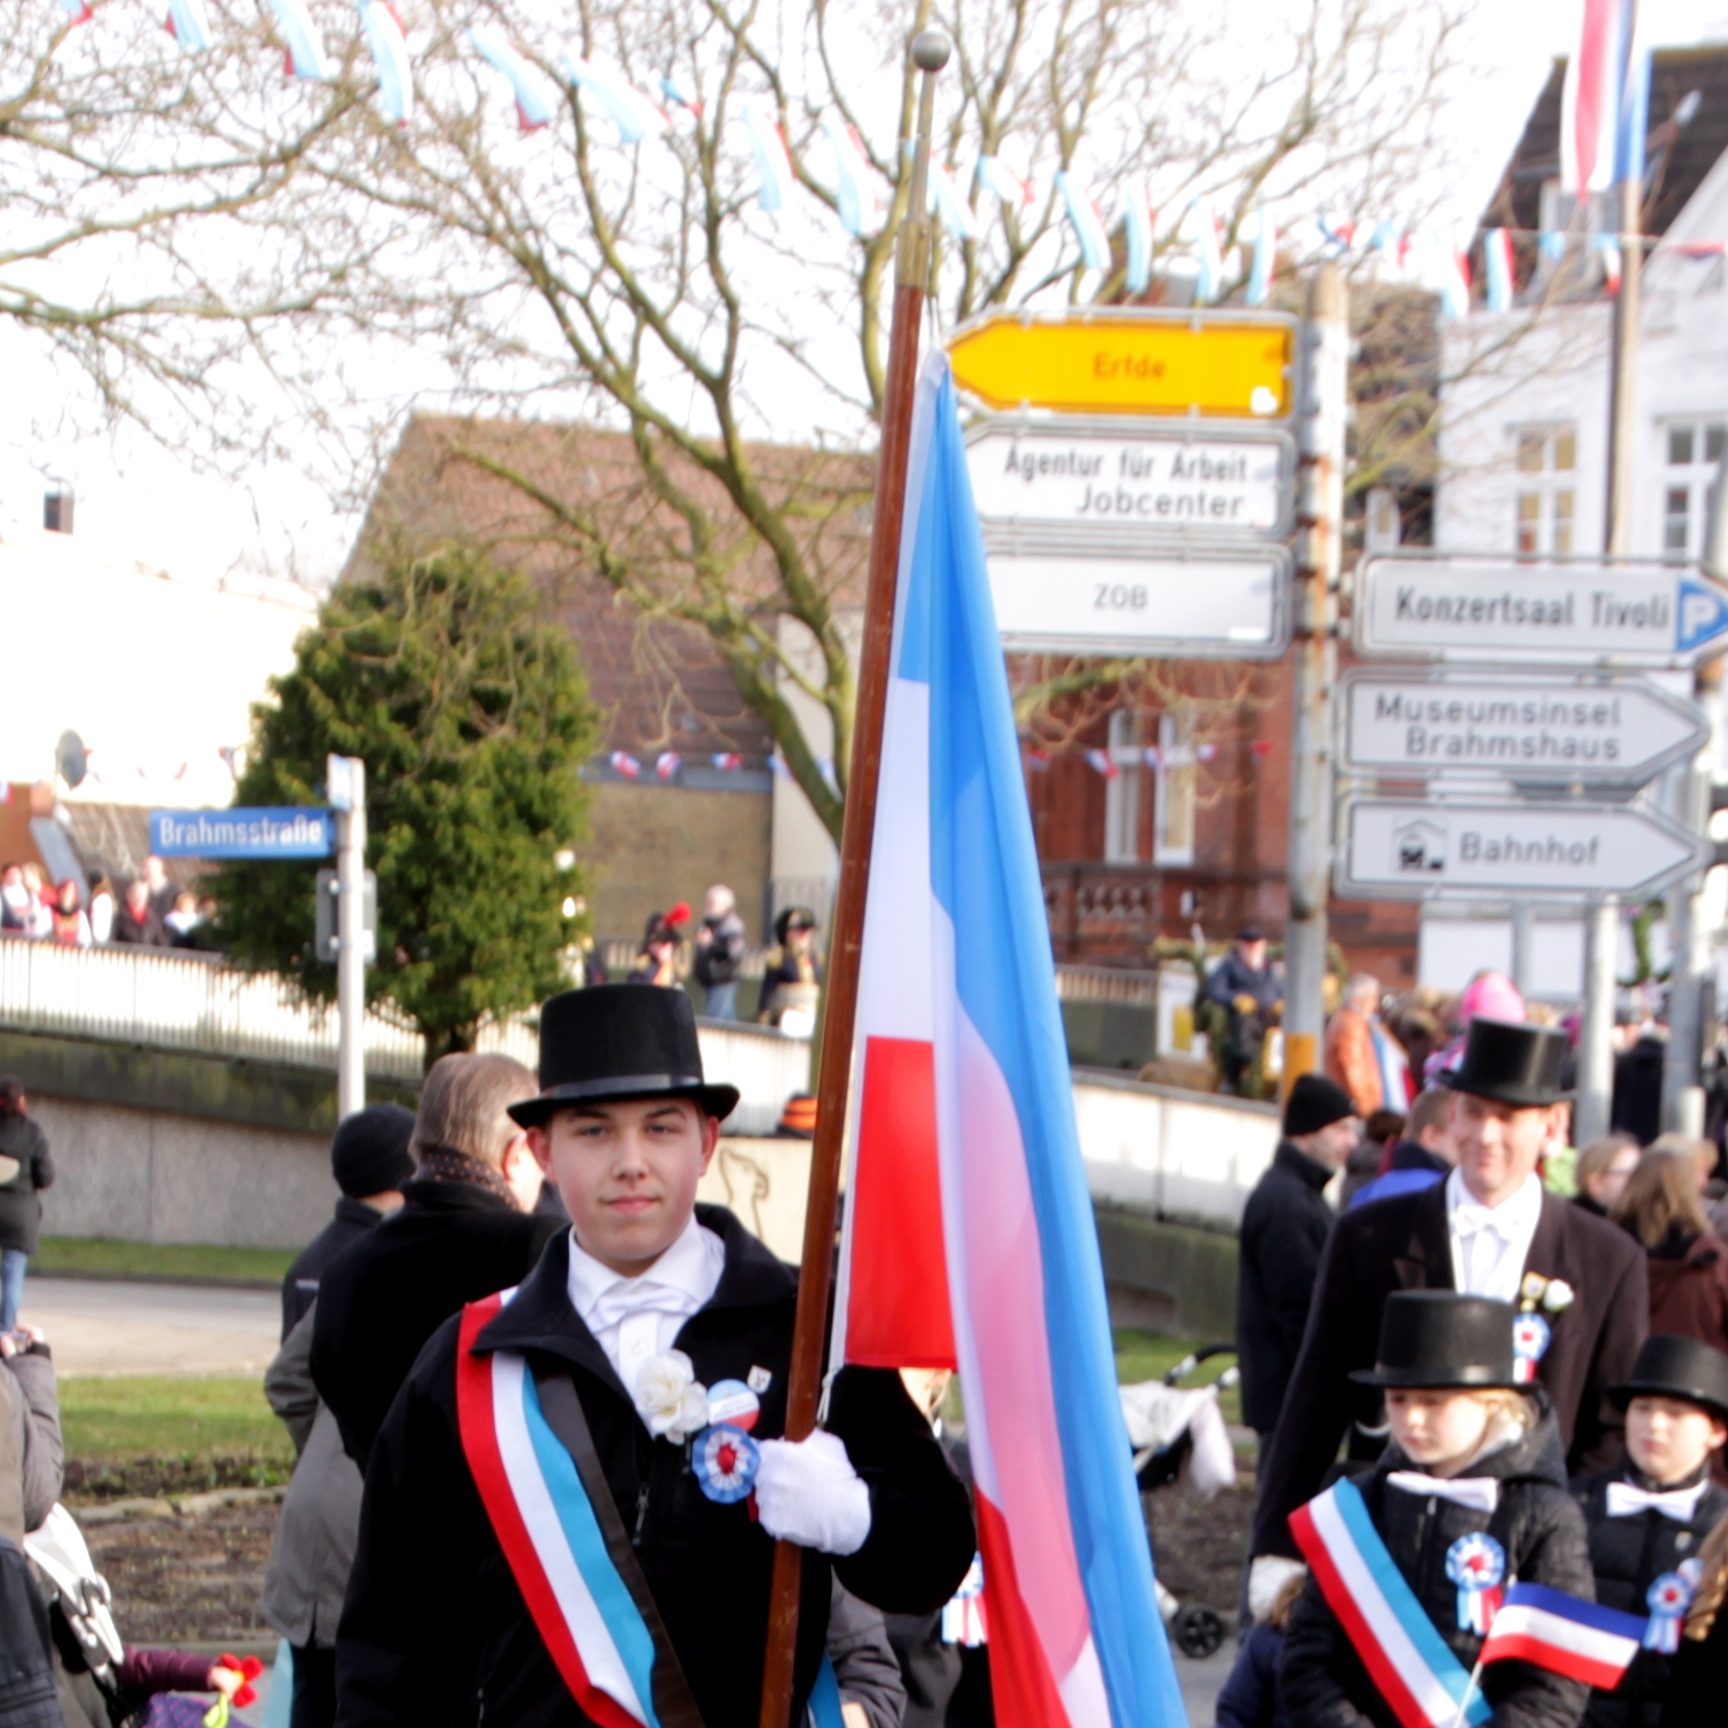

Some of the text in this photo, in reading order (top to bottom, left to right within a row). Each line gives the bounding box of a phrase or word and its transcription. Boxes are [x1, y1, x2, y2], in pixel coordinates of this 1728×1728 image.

[1092, 353, 1166, 378] Erfde
[1005, 446, 1247, 481] Agentur für Arbeit
[1077, 486, 1244, 517] Jobcenter
[1093, 583, 1148, 609] ZOB
[1396, 587, 1718, 641] Konzertsaal Tivoli P
[1375, 694, 1621, 726] Museumsinsel
[1406, 730, 1619, 758] Brahmshaus
[160, 814, 321, 848] Brahmsstraße
[1460, 833, 1600, 864] Bahnhof
